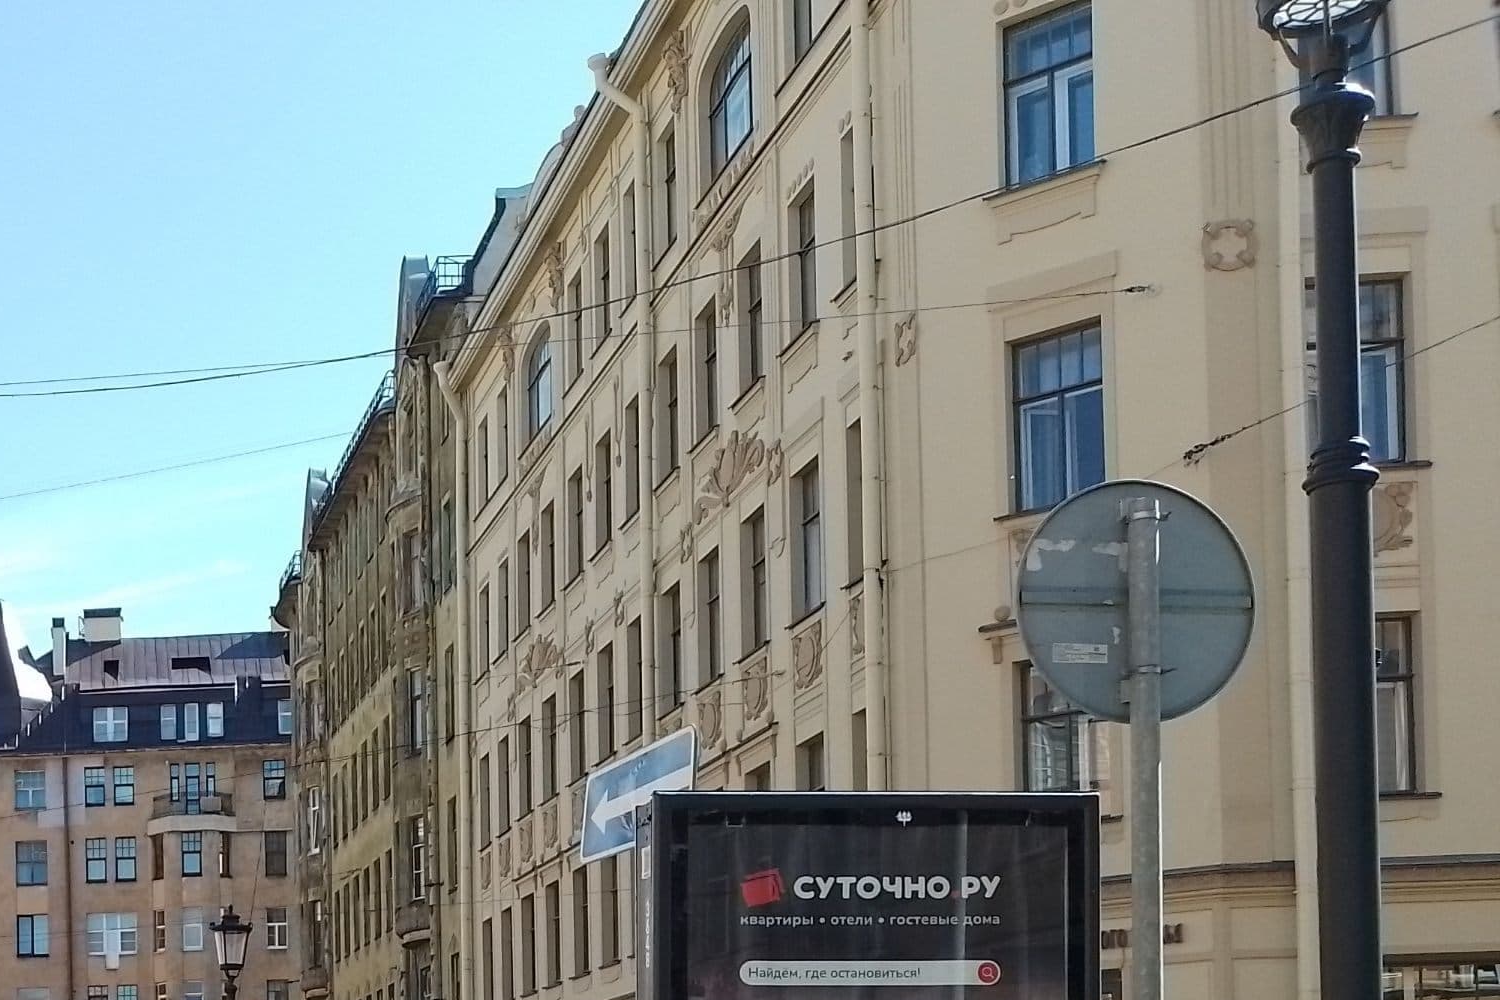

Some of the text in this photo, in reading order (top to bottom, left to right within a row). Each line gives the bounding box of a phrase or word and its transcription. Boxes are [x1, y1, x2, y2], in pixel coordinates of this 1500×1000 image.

[793, 875, 1001, 900] СУТОЧНО.РУ
[740, 915, 1001, 927] квартиры отели гостевые дома
[805, 970, 827, 980] где
[830, 967, 921, 979] остановиться!
